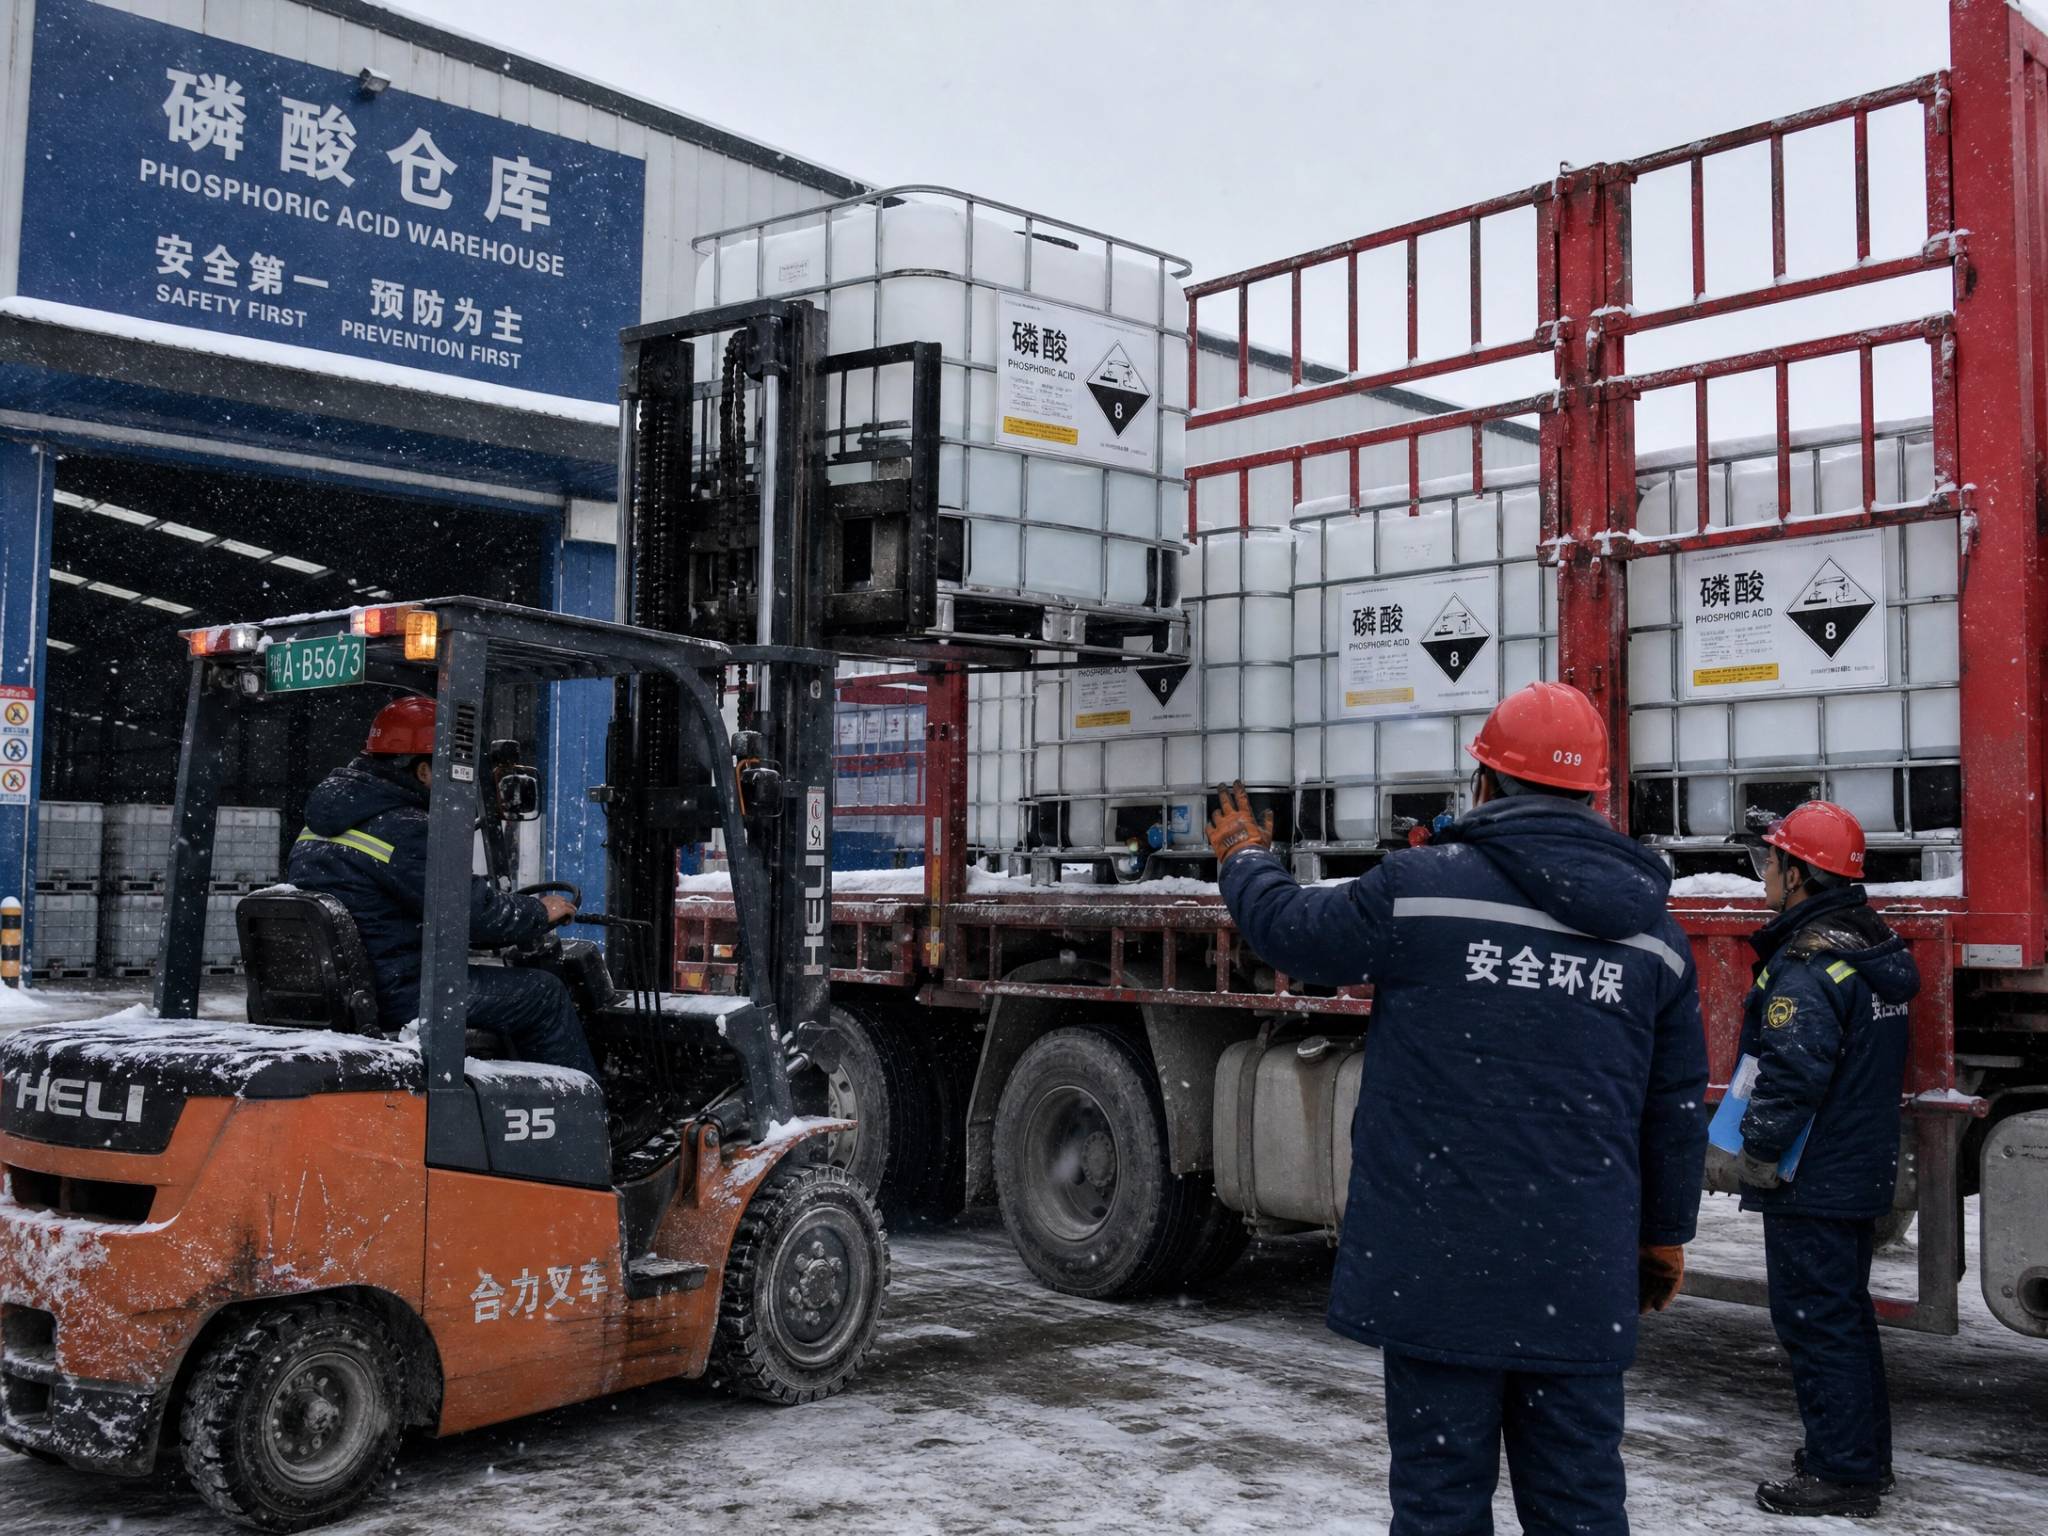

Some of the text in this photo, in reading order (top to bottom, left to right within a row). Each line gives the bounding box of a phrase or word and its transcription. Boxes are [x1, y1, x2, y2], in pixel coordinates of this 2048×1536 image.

[162, 67, 553, 234] 磷酸仓库
[140, 158, 565, 277] PHOSPHORIC ACID WAREHOUSE
[155, 234, 524, 346] 安全第一 预防为主
[156, 283, 308, 329] SAFETY FIRST
[341, 320, 522, 370] PREVENTION FIRST
[1011, 321, 1068, 364] 磷酸
[1008, 358, 1076, 381] PHOSPHORIC ACID
[1114, 402, 1123, 419] 8
[1699, 570, 1765, 608] 磷酸
[1352, 604, 1404, 637] 磷酸
[1695, 608, 1773, 625] PHOSPHORIC ACID
[1825, 622, 1837, 640] 8
[1349, 638, 1410, 651] PHOSPHORIC ACID
[1449, 651, 1460, 668] 8
[1160, 678, 1168, 693] 8
[1553, 750, 1582, 766] 039
[805, 855, 825, 975] HELI
[1465, 939, 1624, 1004] 安全环保
[16, 1072, 145, 1123] HELI
[504, 1107, 556, 1141] 35
[470, 1257, 608, 1323] 合力叉车
